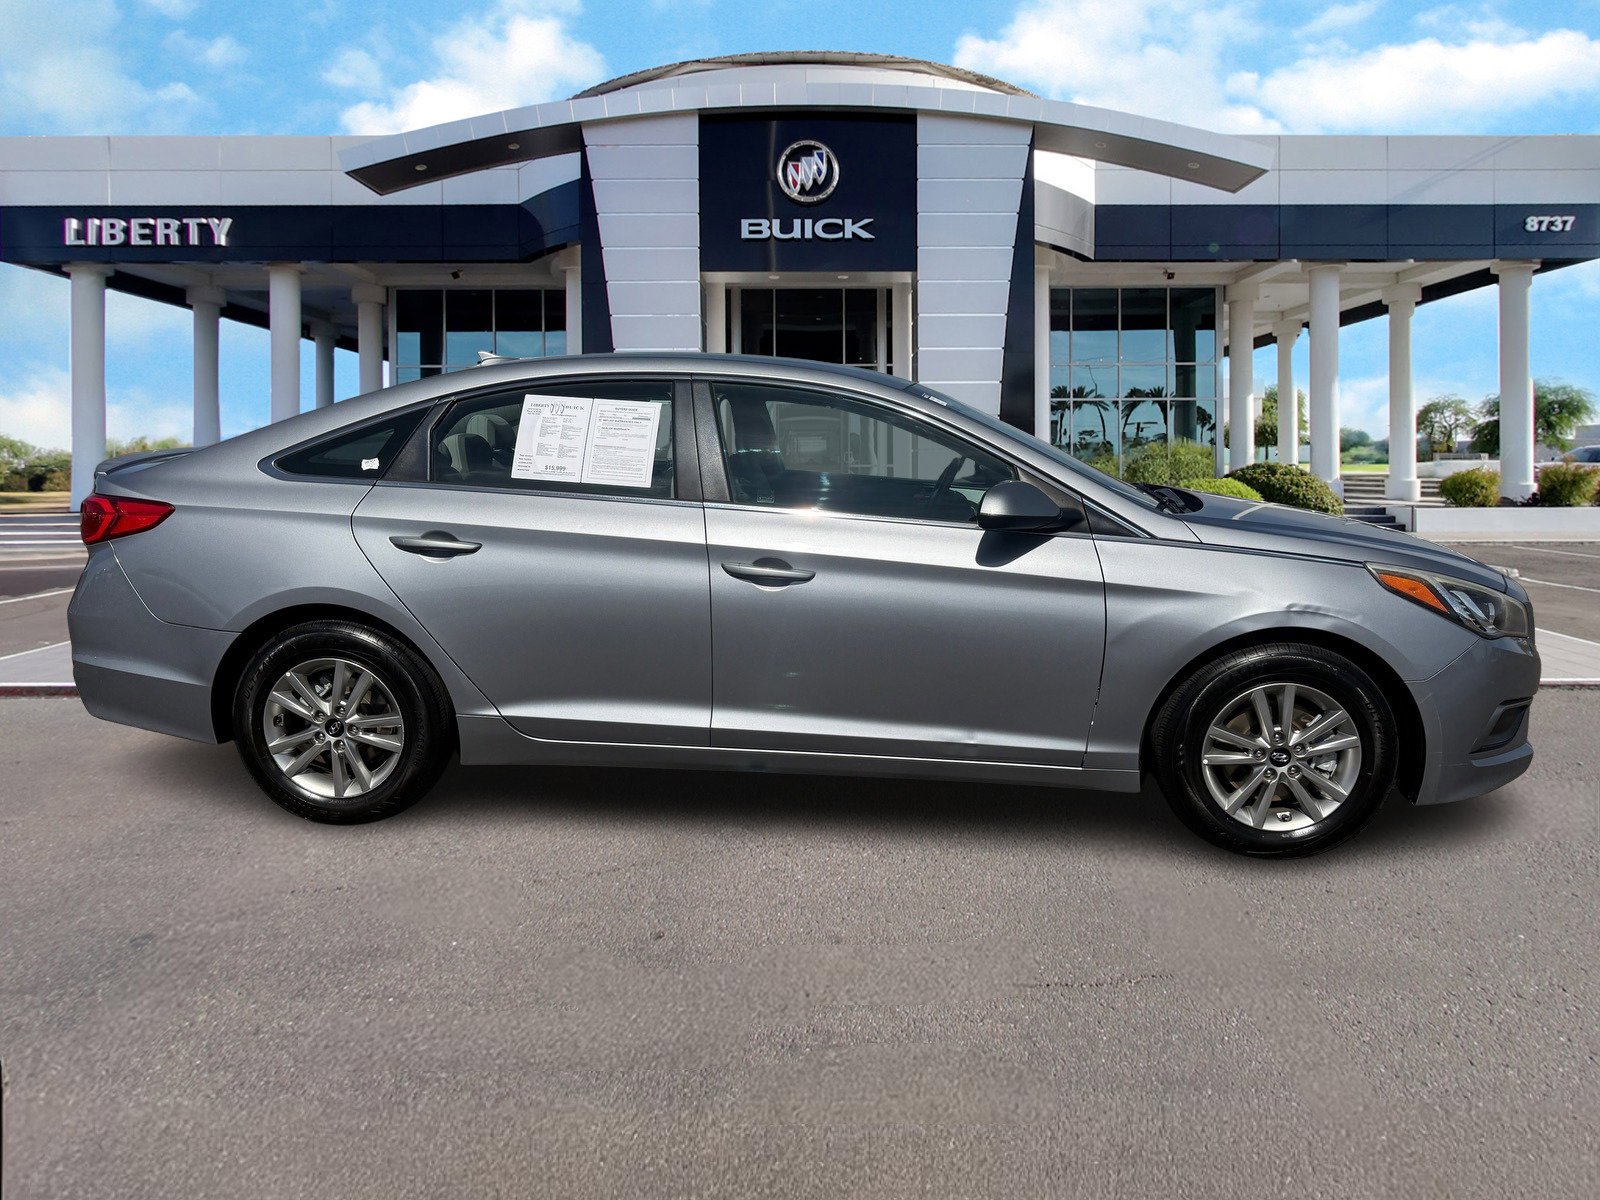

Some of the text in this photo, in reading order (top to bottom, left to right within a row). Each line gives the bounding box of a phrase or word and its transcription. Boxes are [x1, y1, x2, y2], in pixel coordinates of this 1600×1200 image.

[64, 217, 233, 247] LIBERTY
[740, 217, 876, 240] BUICK
[1524, 215, 1576, 232] 8737
